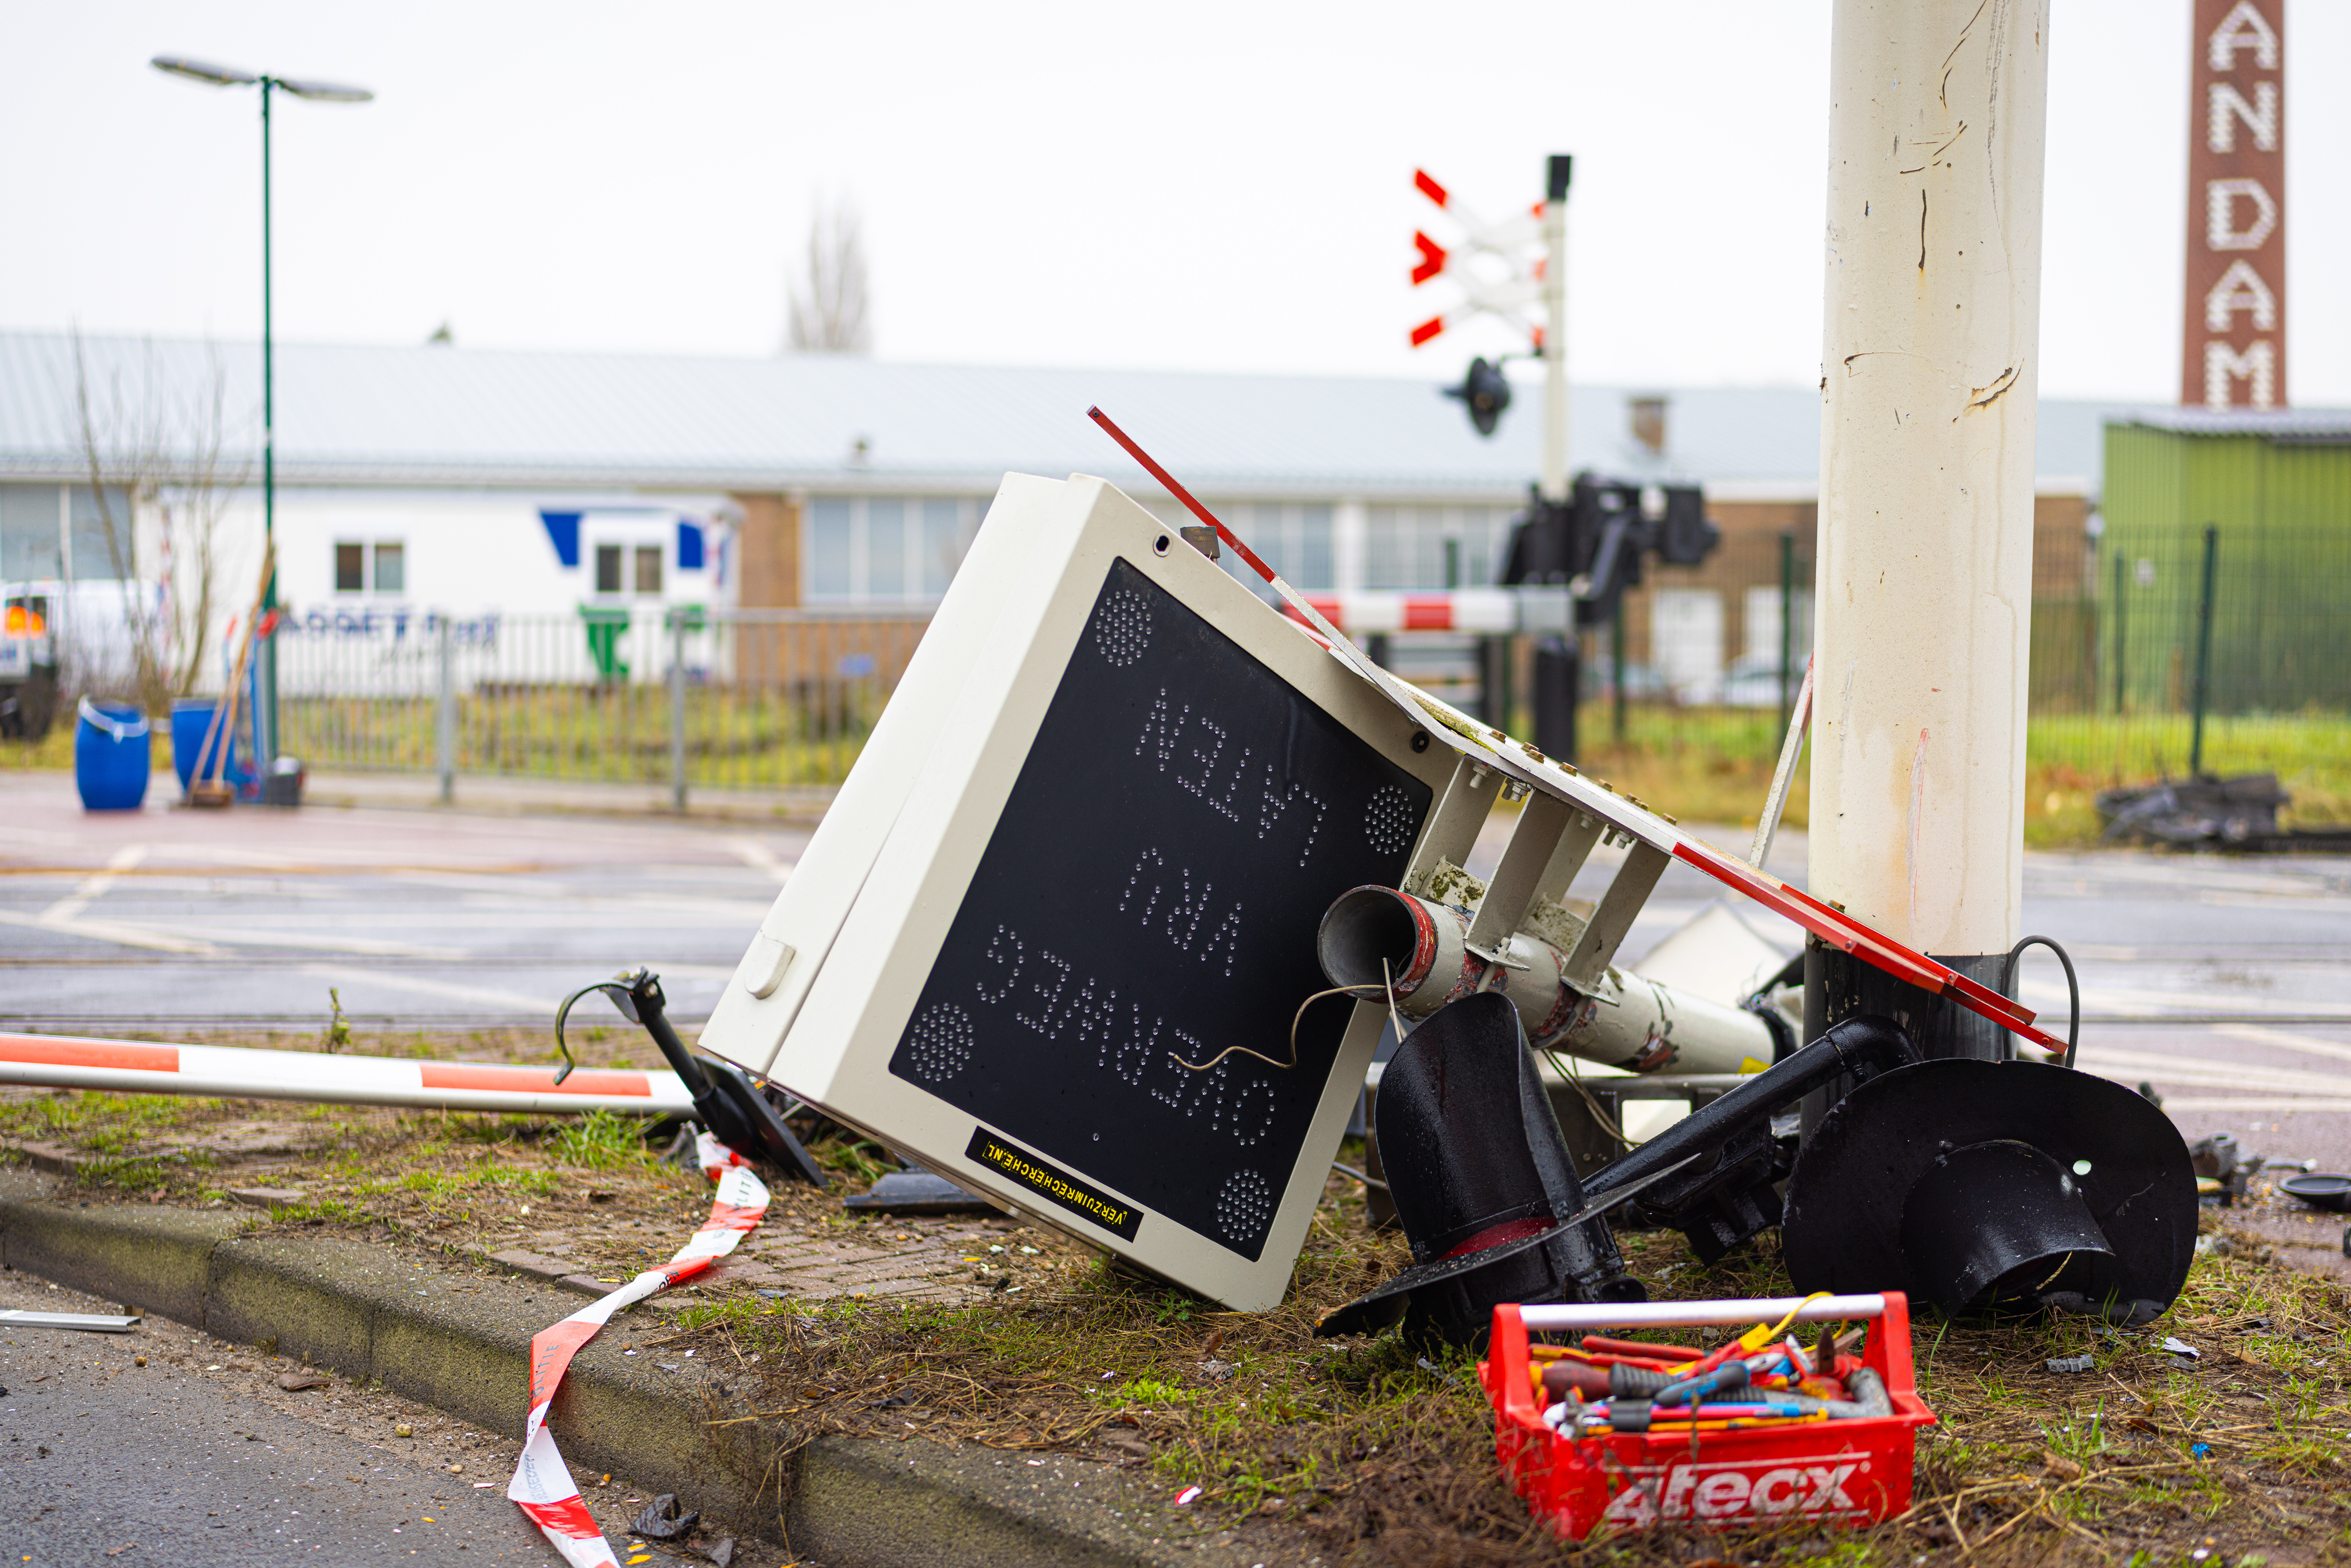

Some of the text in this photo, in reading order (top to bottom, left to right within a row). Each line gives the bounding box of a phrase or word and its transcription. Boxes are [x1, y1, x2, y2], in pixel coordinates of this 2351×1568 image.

[2204, 0, 2280, 412] ANDAM
[1135, 689, 1326, 867] LATEN
[977, 925, 1275, 1144] OVERWEG
[984, 1142, 1127, 1225] VERZUIMRECHERCHE.NL
